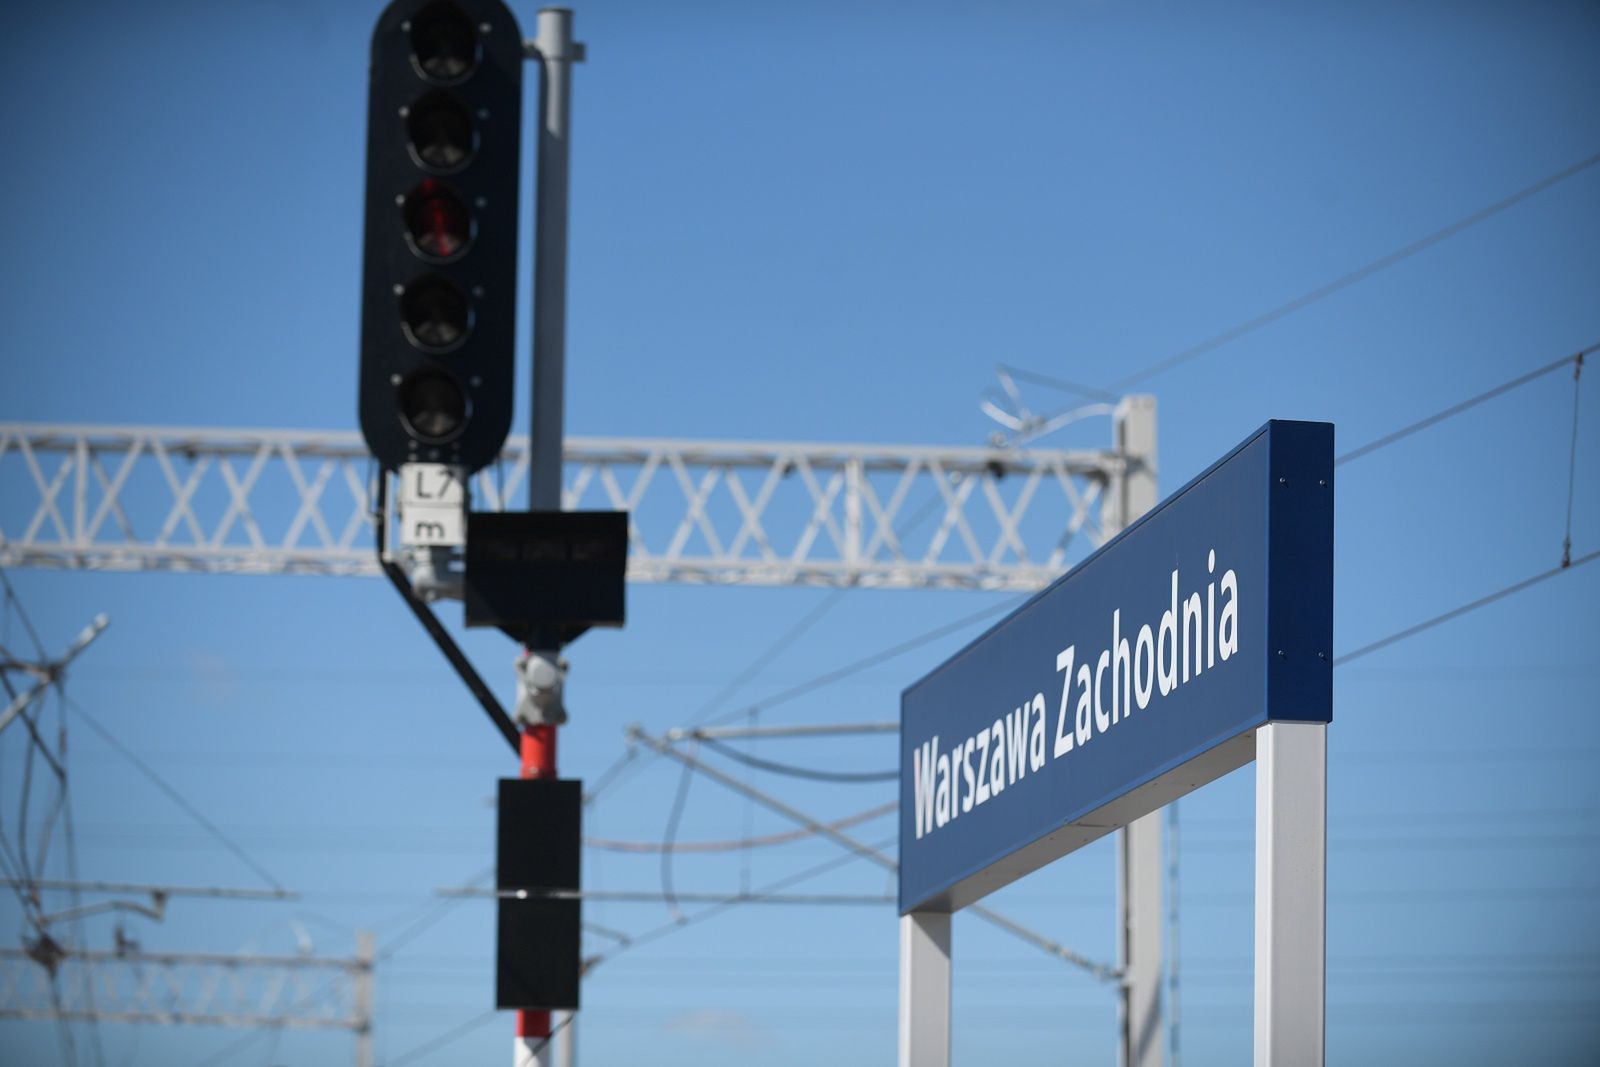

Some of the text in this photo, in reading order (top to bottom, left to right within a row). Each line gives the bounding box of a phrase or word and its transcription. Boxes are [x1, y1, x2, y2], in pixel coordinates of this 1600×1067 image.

[415, 521, 445, 538] m
[913, 549, 1239, 840] Warszawa Zachodnia
